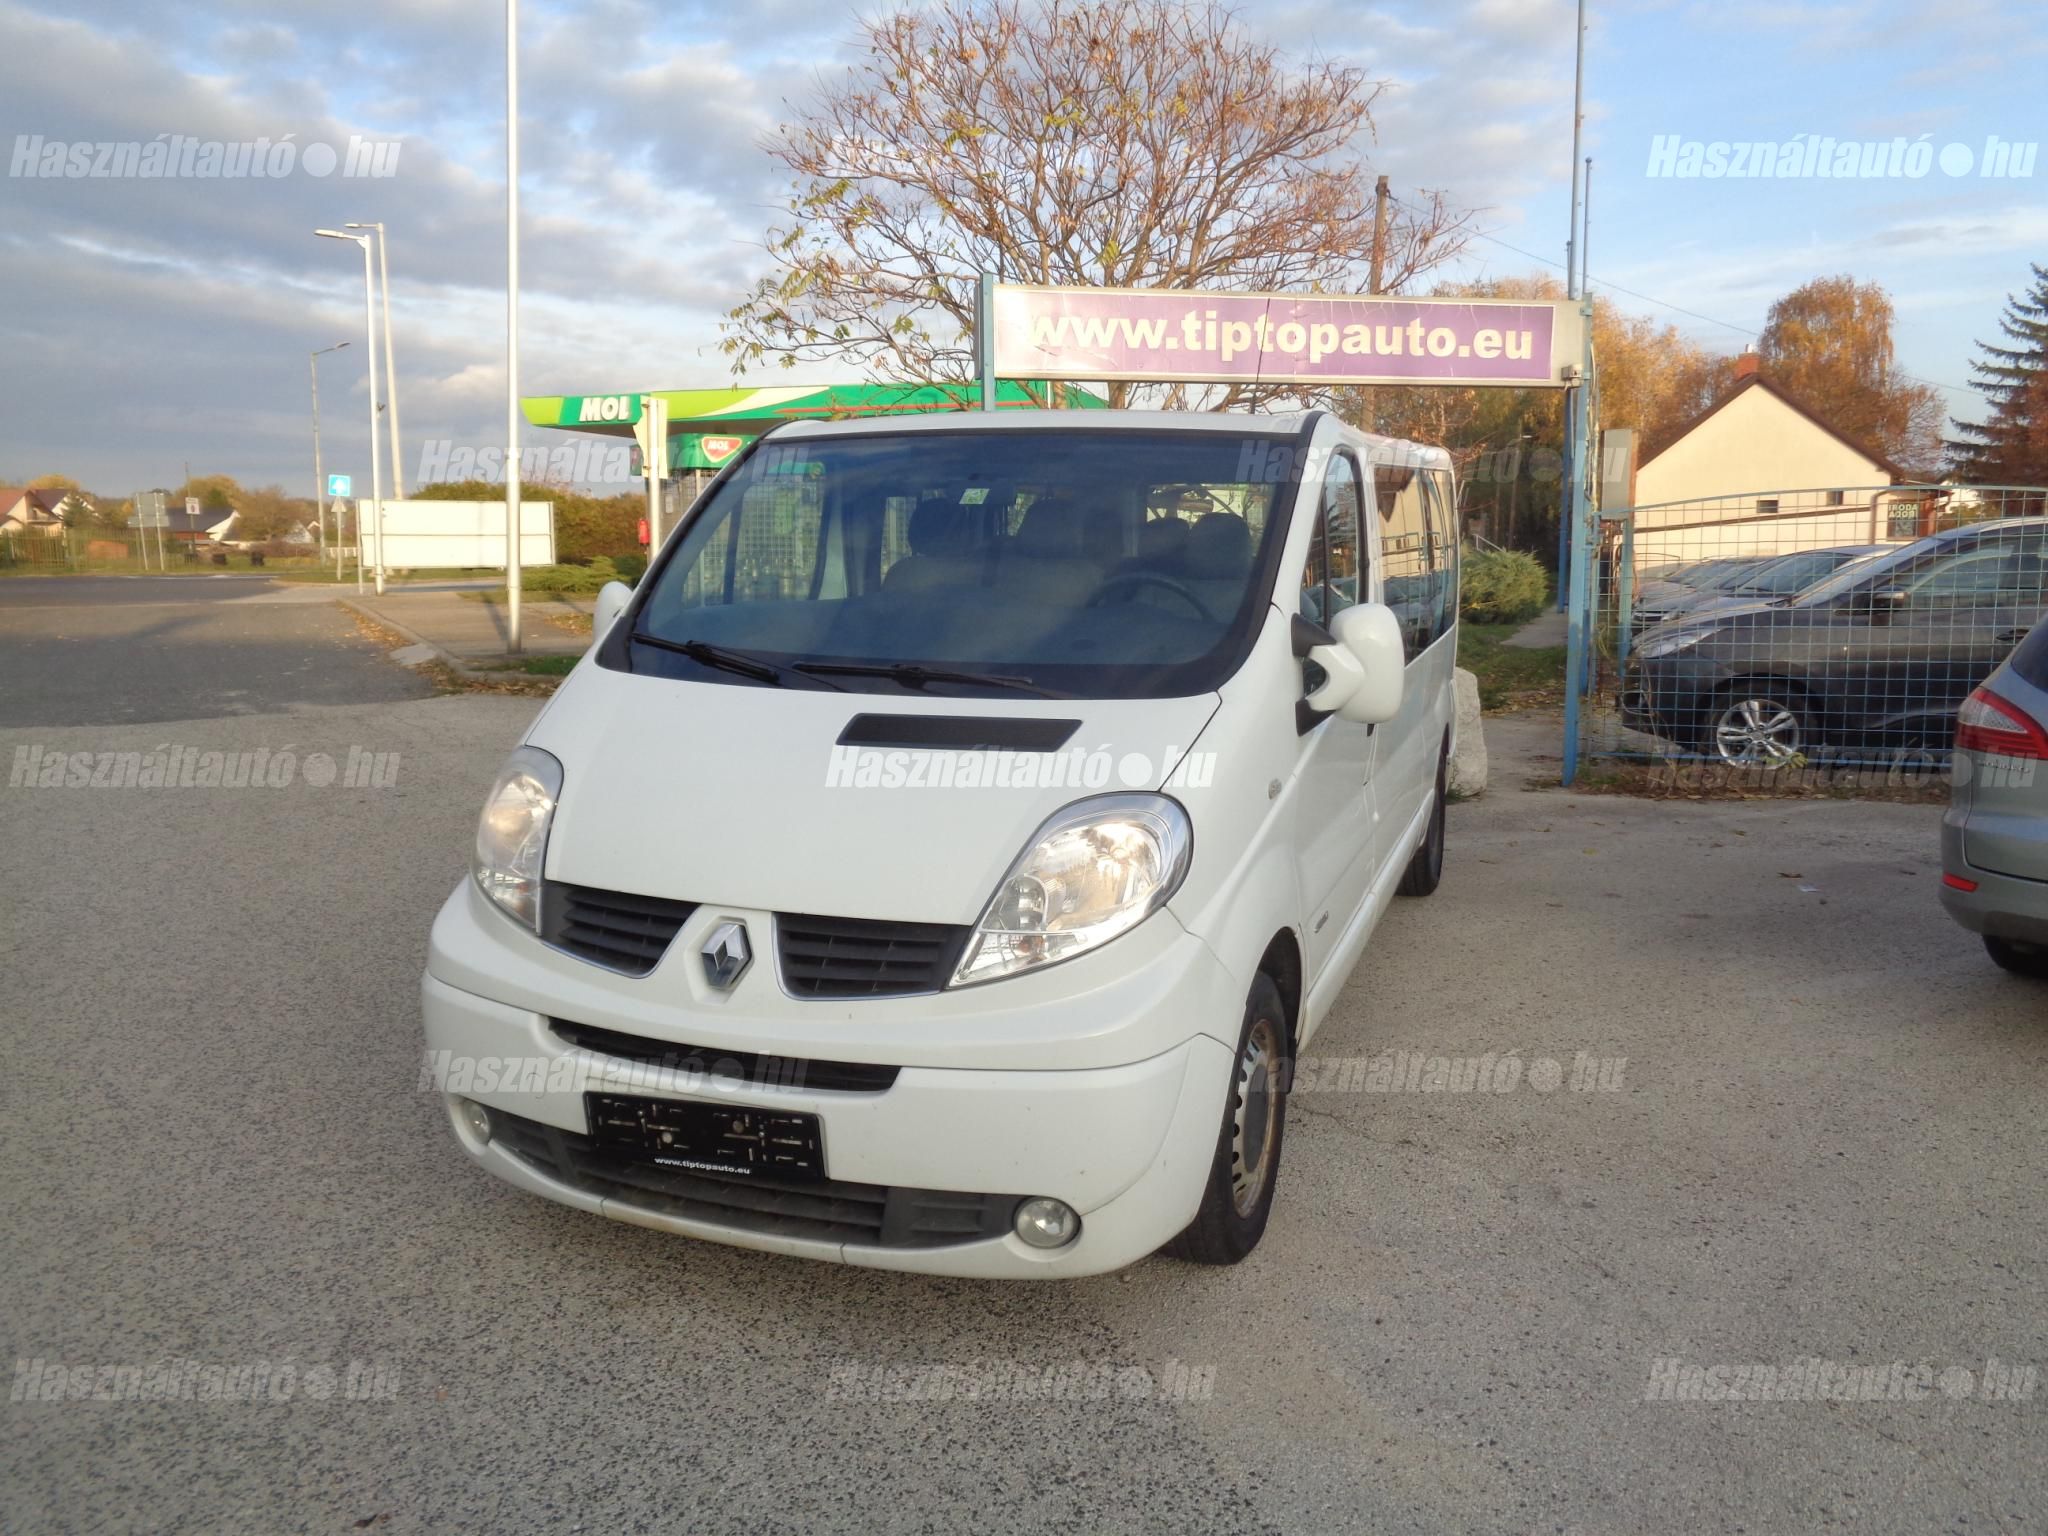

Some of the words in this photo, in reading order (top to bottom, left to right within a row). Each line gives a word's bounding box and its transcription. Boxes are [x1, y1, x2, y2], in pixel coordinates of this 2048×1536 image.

[1030, 309, 1533, 362] www.tiptopauto.eu
[578, 396, 630, 423] MOL
[707, 439, 730, 451] MOL
[654, 1157, 751, 1175] www.tiptopauto.eu
